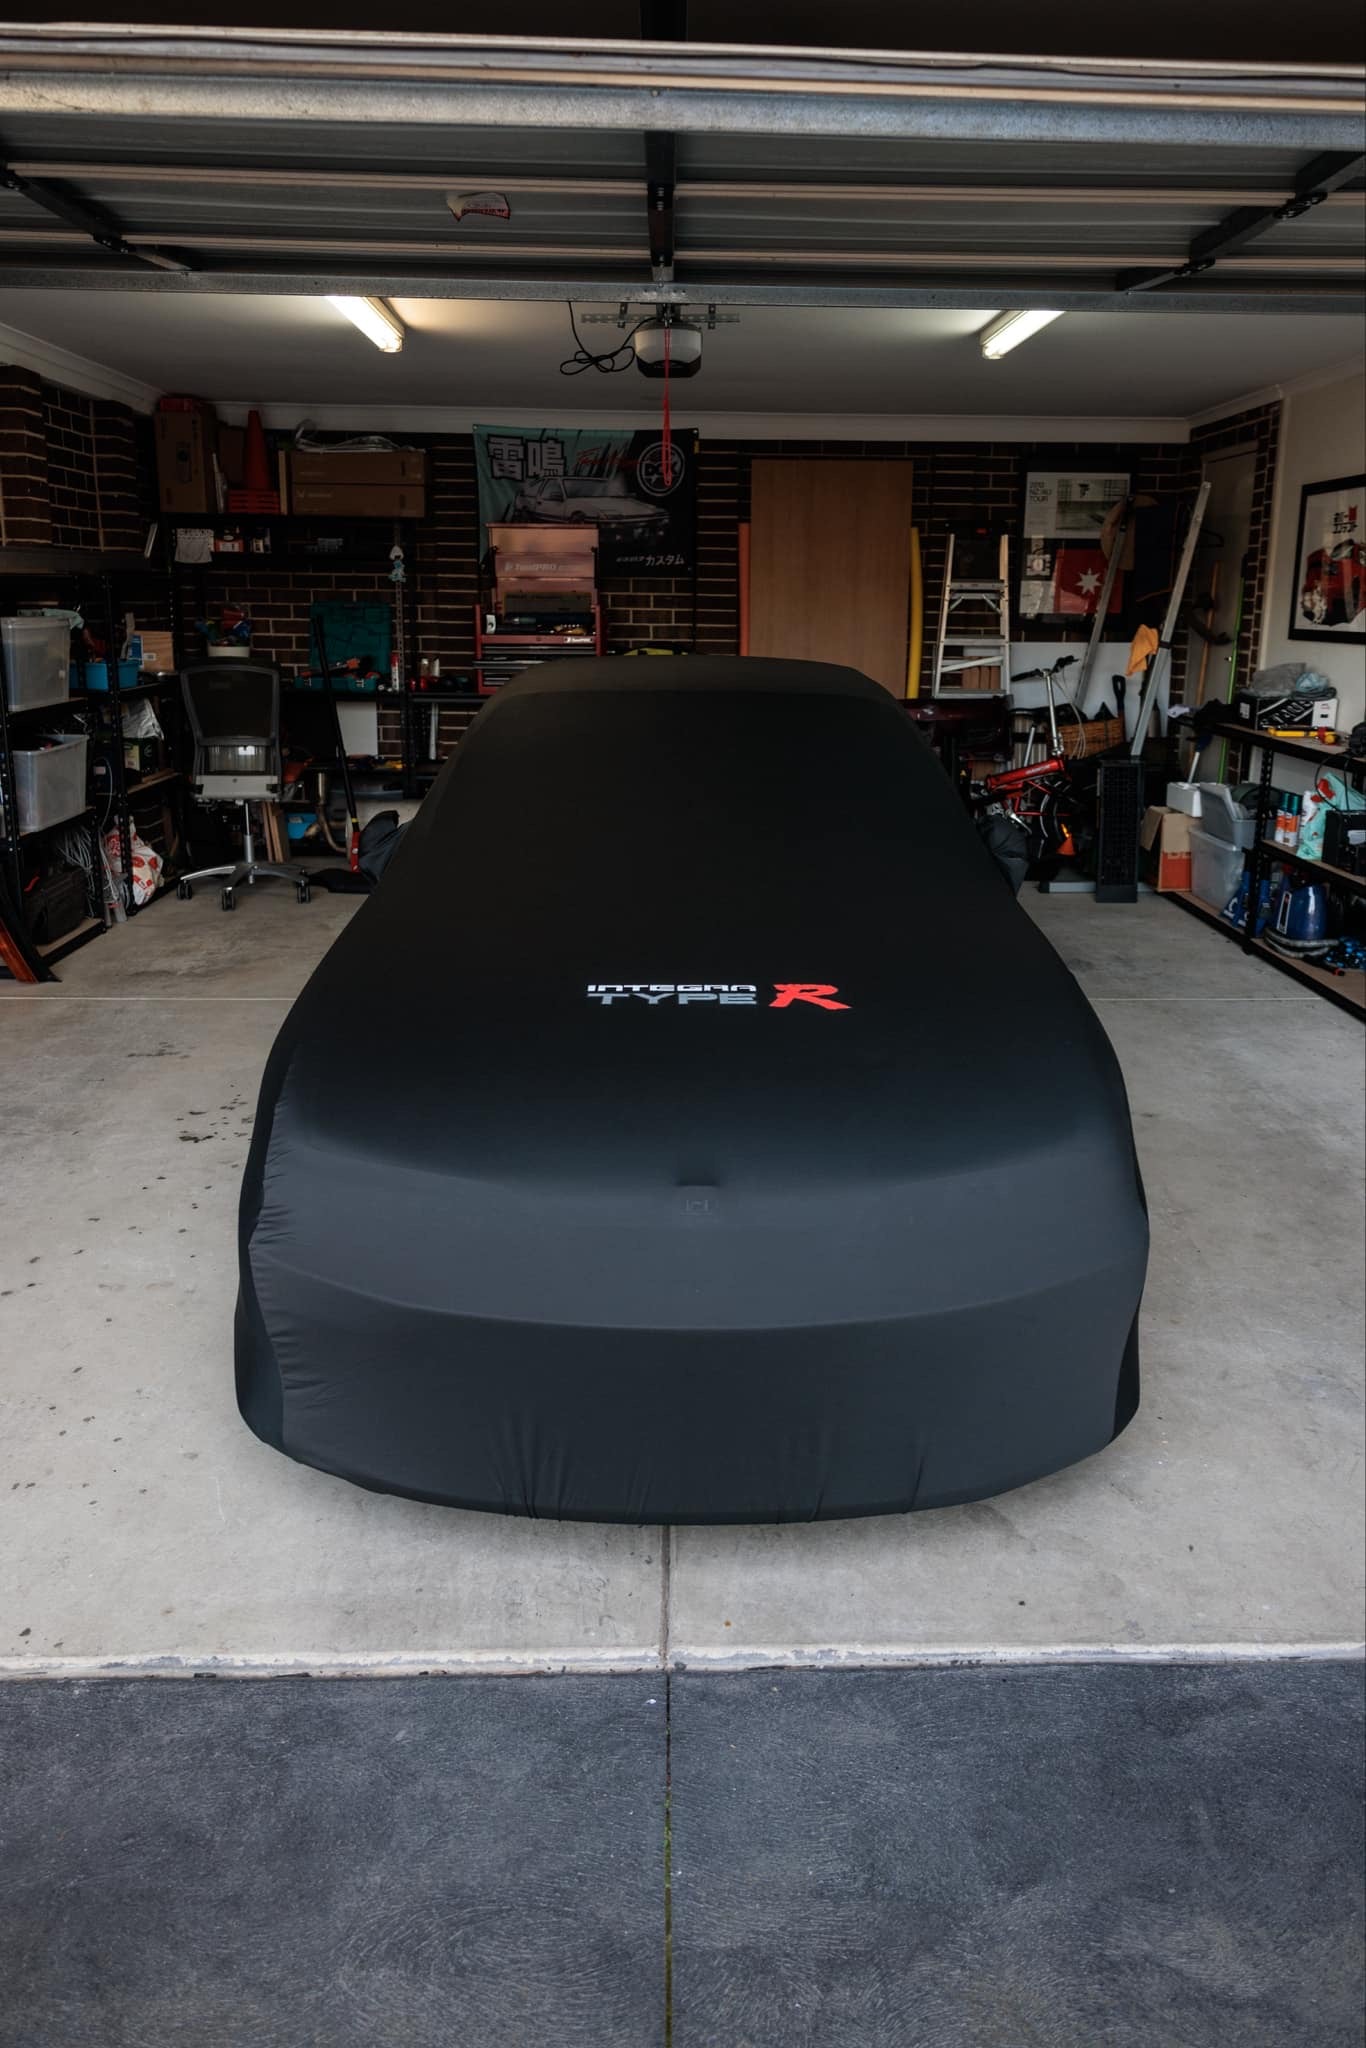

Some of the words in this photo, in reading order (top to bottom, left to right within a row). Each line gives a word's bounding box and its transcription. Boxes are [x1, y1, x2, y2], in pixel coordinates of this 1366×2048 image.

[487, 434, 566, 481] 雷鳴
[645, 554, 685, 567] カスタム
[587, 984, 757, 992] INTEGRA
[587, 992, 757, 1005] TYPE
[768, 983, 853, 1011] R
